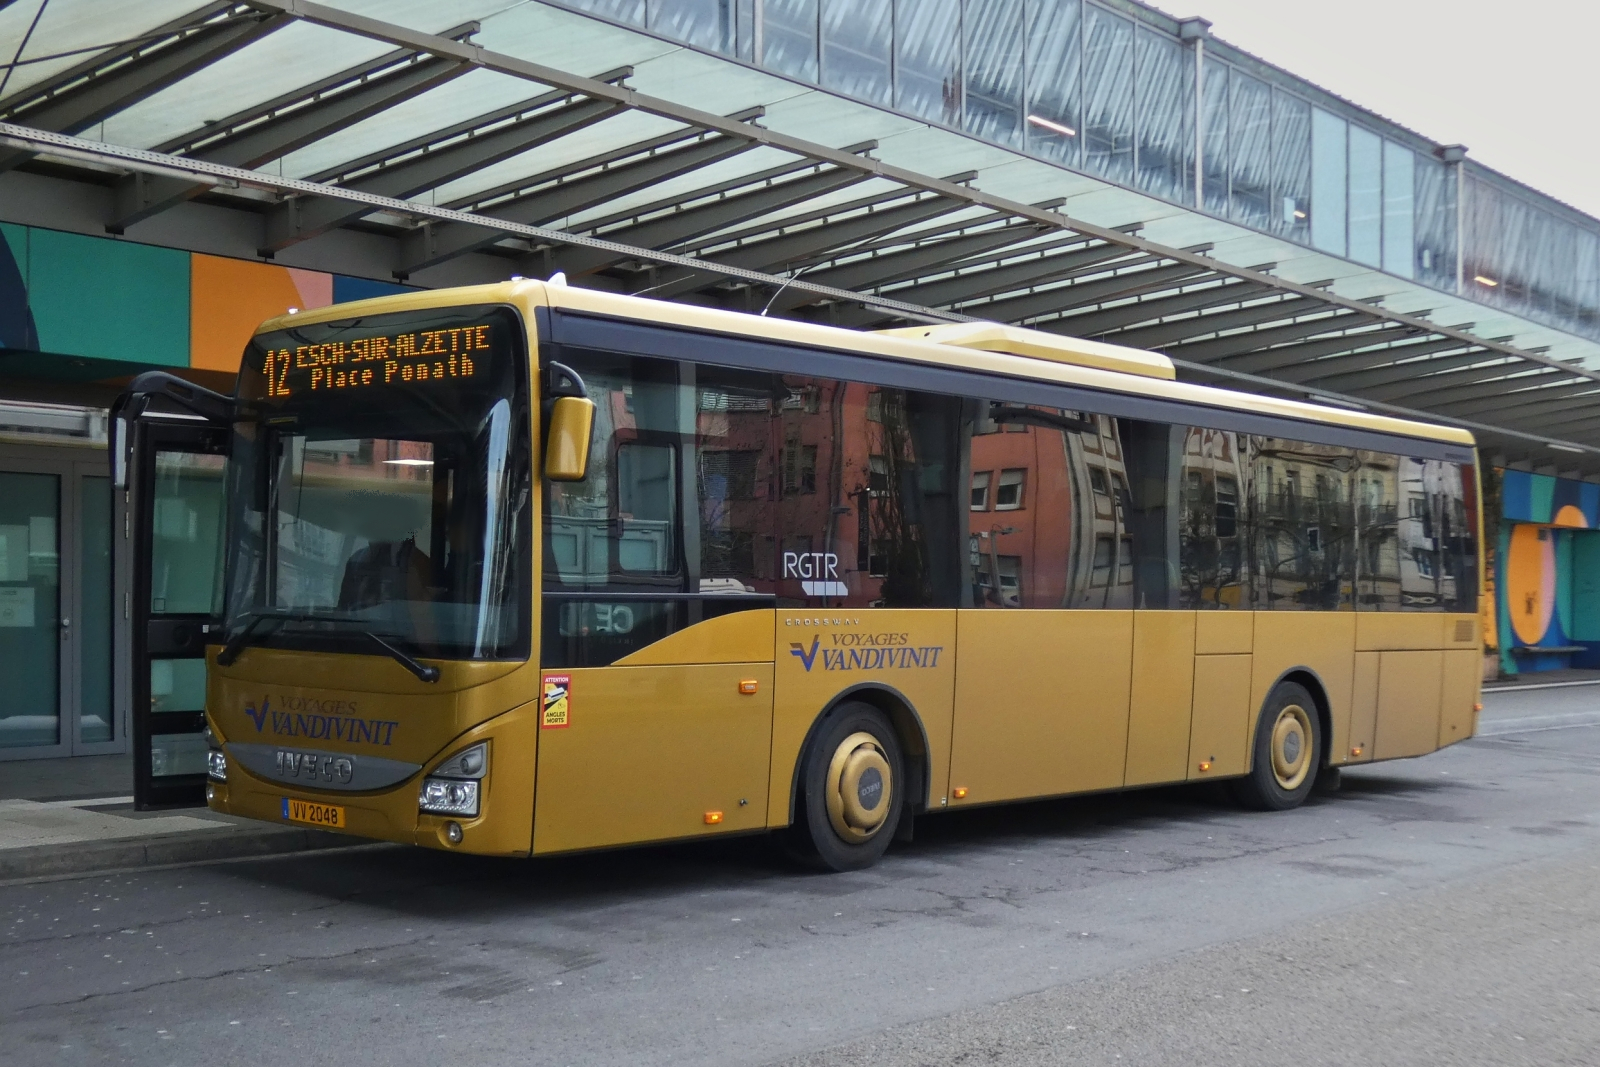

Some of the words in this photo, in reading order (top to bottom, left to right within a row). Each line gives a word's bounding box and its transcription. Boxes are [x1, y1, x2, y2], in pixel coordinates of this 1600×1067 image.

[296, 325, 490, 368] ESCH-SUR-ALZETTE
[262, 348, 291, 396] 12
[311, 366, 374, 390] Place
[384, 353, 474, 383] Ponath
[784, 552, 838, 578] RGTR
[785, 618, 860, 626] CROSSWAY
[832, 632, 909, 646] VOYAGES
[822, 646, 943, 671] VANDIVINIT
[279, 695, 357, 715] VOYAGES
[271, 710, 399, 746] VANDIVINIT
[275, 751, 353, 784] IVECO
[293, 802, 307, 820] VV
[308, 804, 338, 825] 2048
